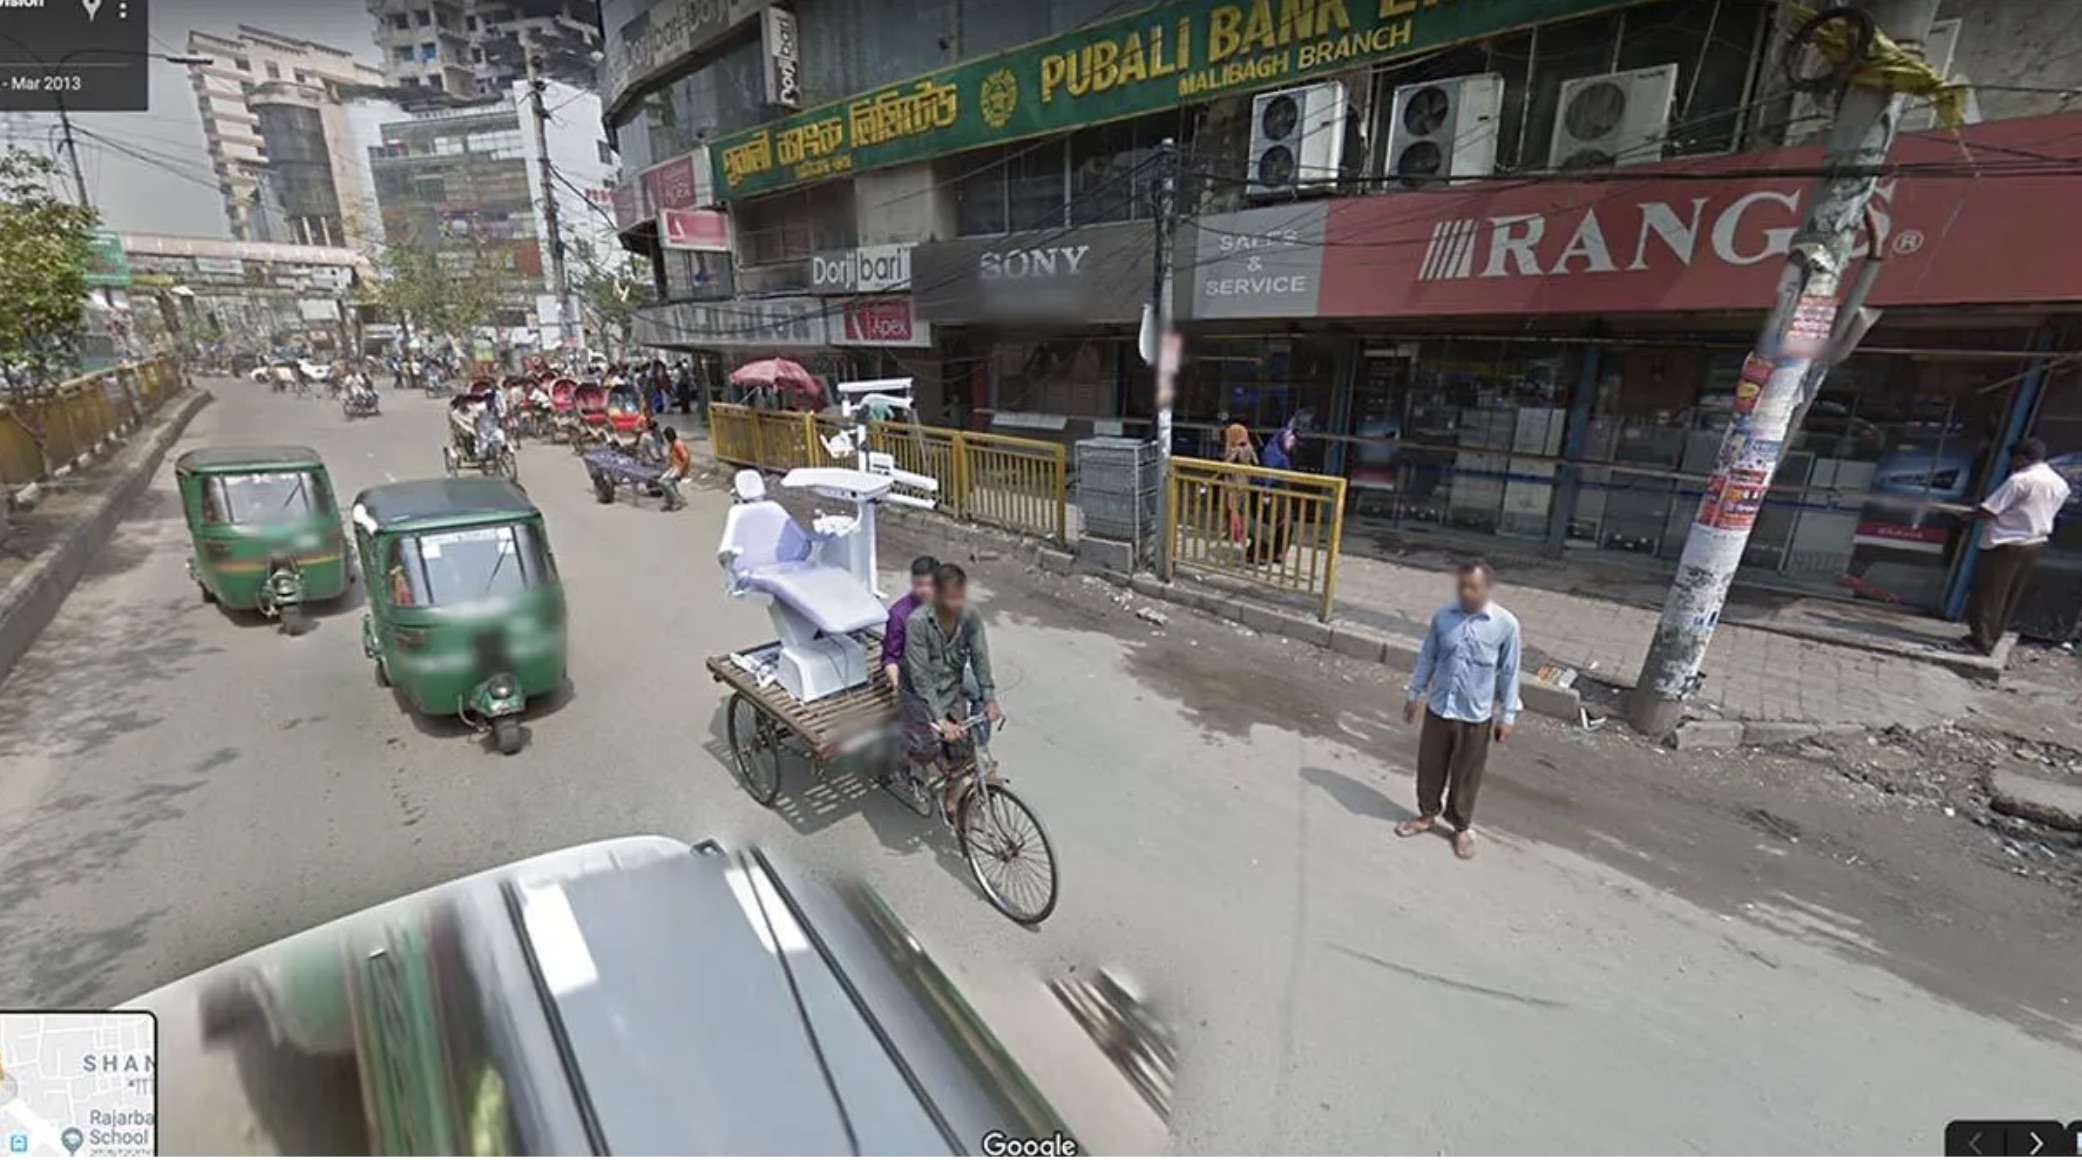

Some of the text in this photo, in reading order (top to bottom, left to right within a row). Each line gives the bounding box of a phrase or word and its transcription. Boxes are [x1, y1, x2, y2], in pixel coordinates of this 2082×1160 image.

[1041, 0, 1350, 103] PUBALI BANK
[1177, 18, 1413, 96] MALIBAGH BRANCH
[1220, 226, 1299, 252] SALES
[980, 245, 1090, 280] SONY
[1247, 255, 1262, 273] &
[1205, 275, 1308, 297] SERVICE
